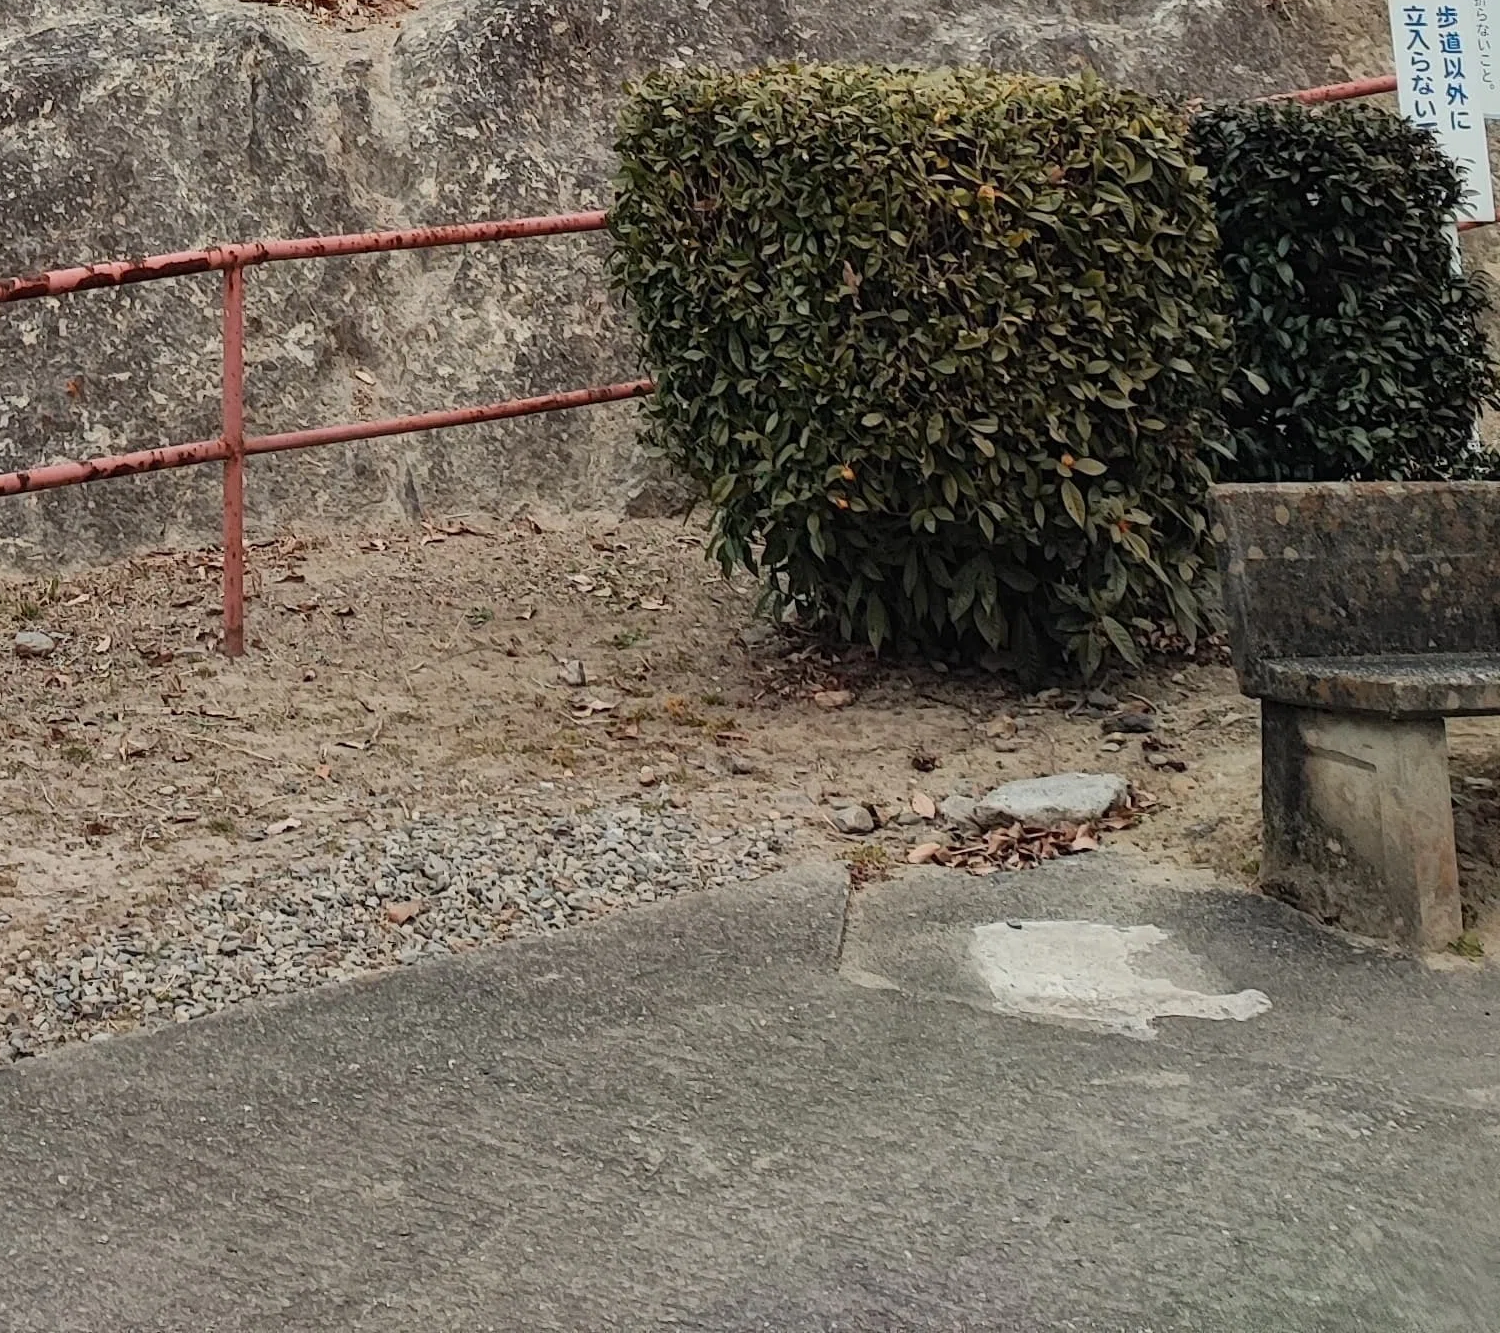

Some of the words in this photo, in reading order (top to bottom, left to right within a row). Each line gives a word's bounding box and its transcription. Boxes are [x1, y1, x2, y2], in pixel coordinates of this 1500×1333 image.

[1403, 5, 1438, 129] 立入らない
[1436, 6, 1471, 130] 歩道以外に
